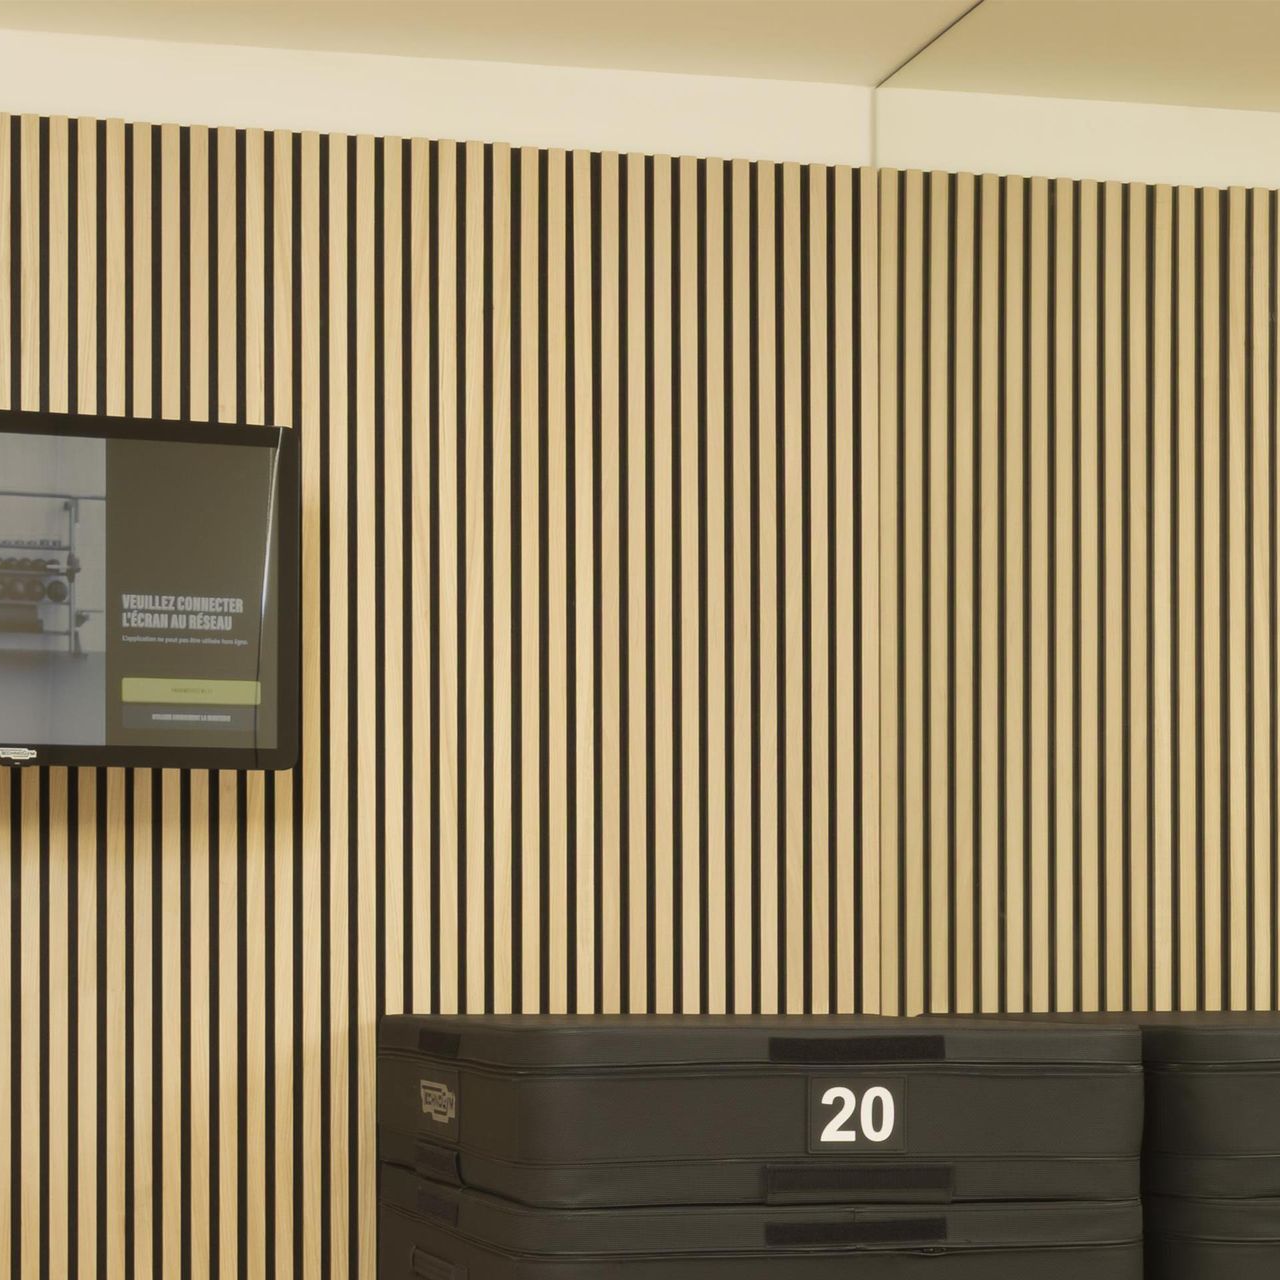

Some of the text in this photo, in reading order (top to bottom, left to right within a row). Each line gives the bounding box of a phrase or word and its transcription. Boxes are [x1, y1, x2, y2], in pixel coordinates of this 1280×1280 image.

[122, 594, 244, 613] VEUILLEZ CONNECTER
[122, 610, 233, 631] L'ÉCRAN AU RÉSEAU
[820, 1086, 895, 1142] 20
